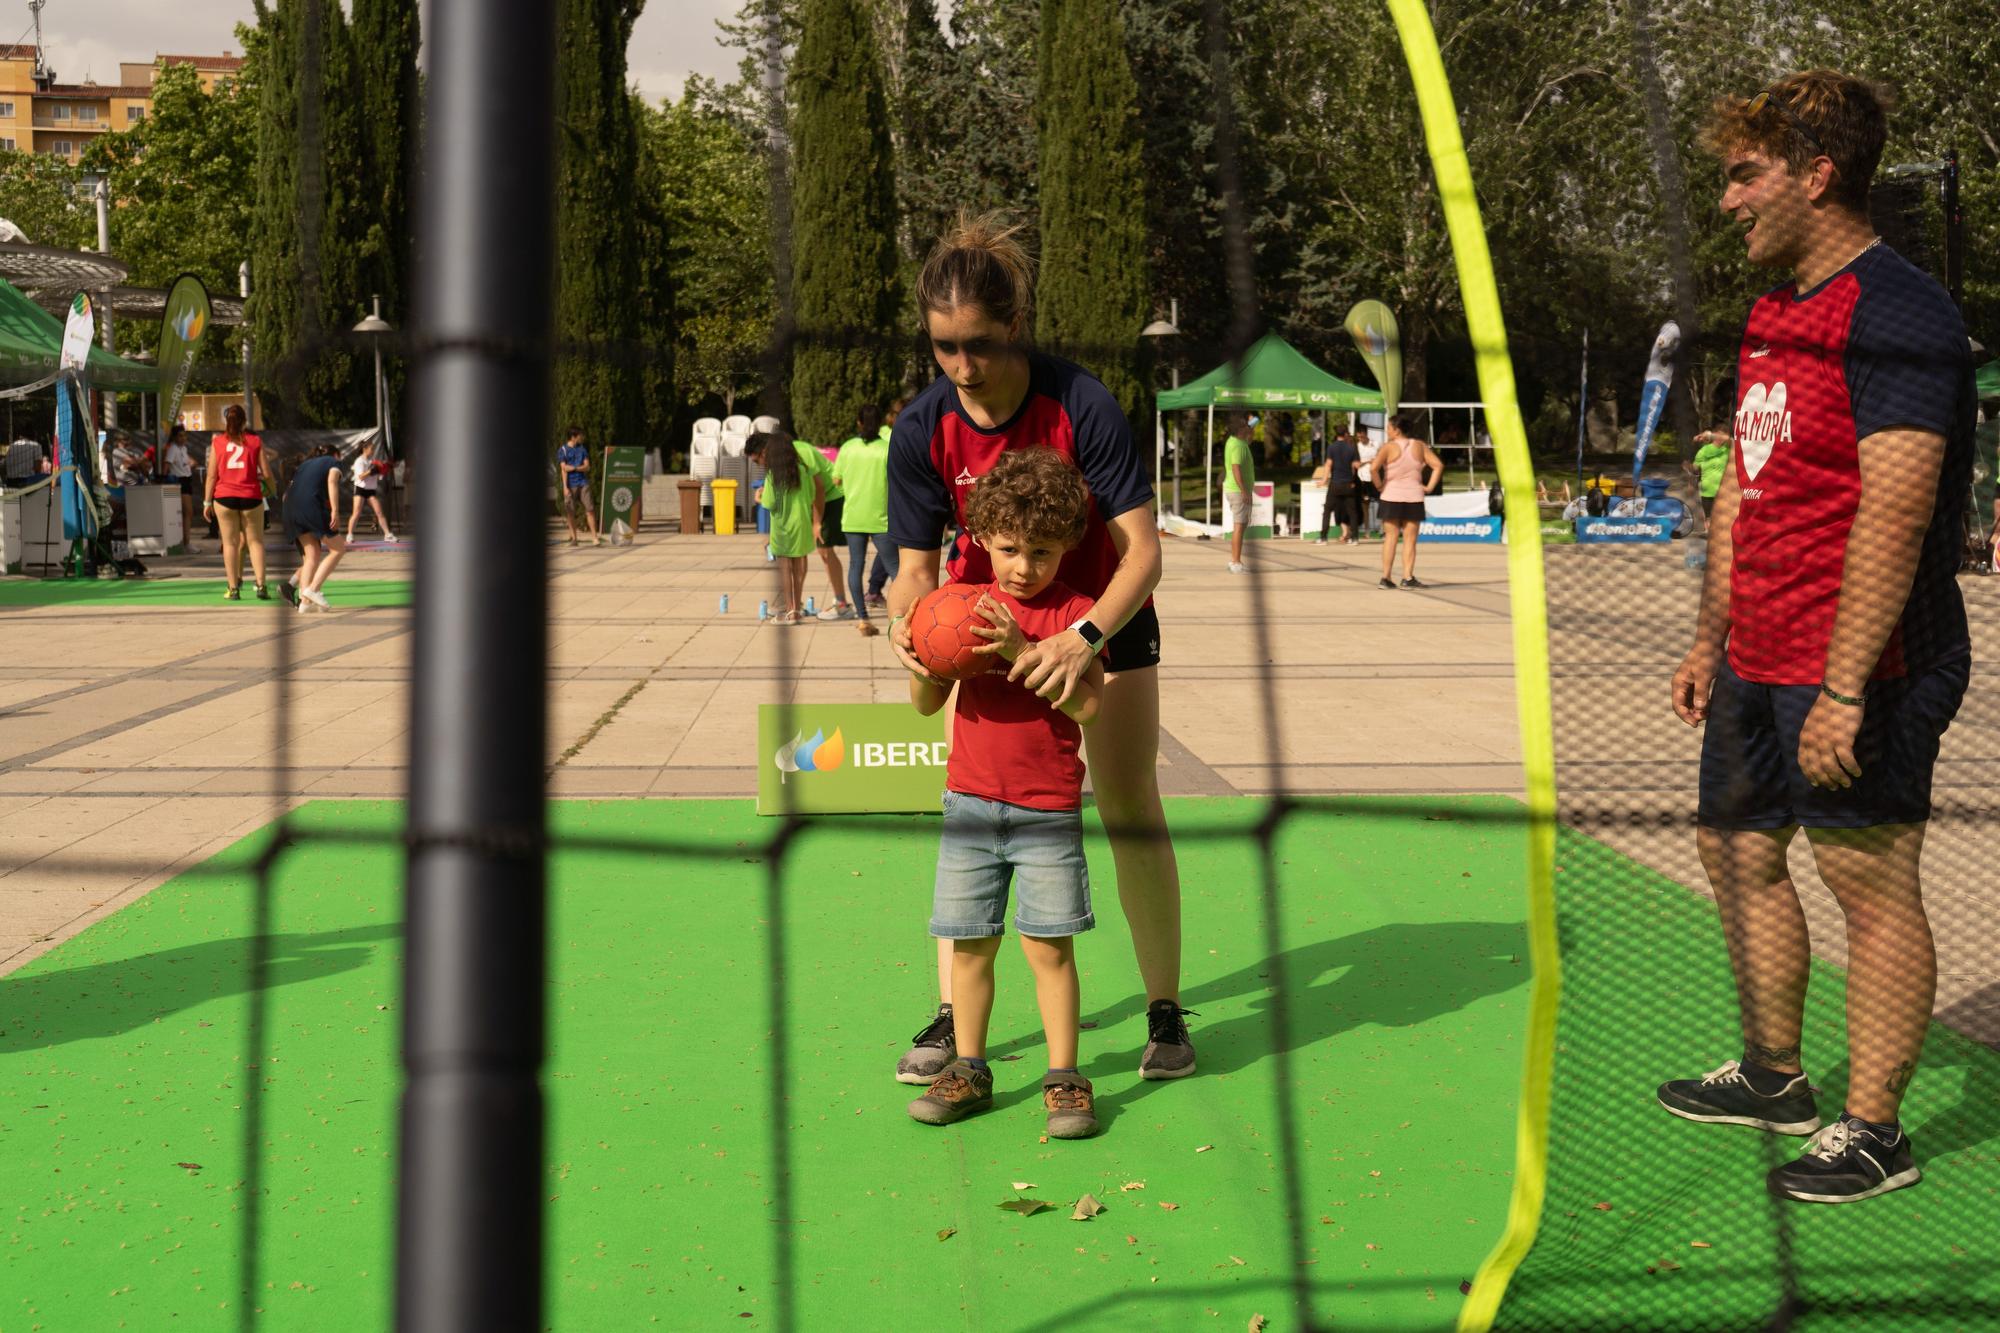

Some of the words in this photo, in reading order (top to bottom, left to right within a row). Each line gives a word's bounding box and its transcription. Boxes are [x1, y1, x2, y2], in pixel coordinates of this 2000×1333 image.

[168, 350, 194, 422] IBERDROLA
[226, 442, 246, 469] 2
[1586, 522, 1662, 537] #RemoEsp
[853, 742, 948, 767] IBERD
